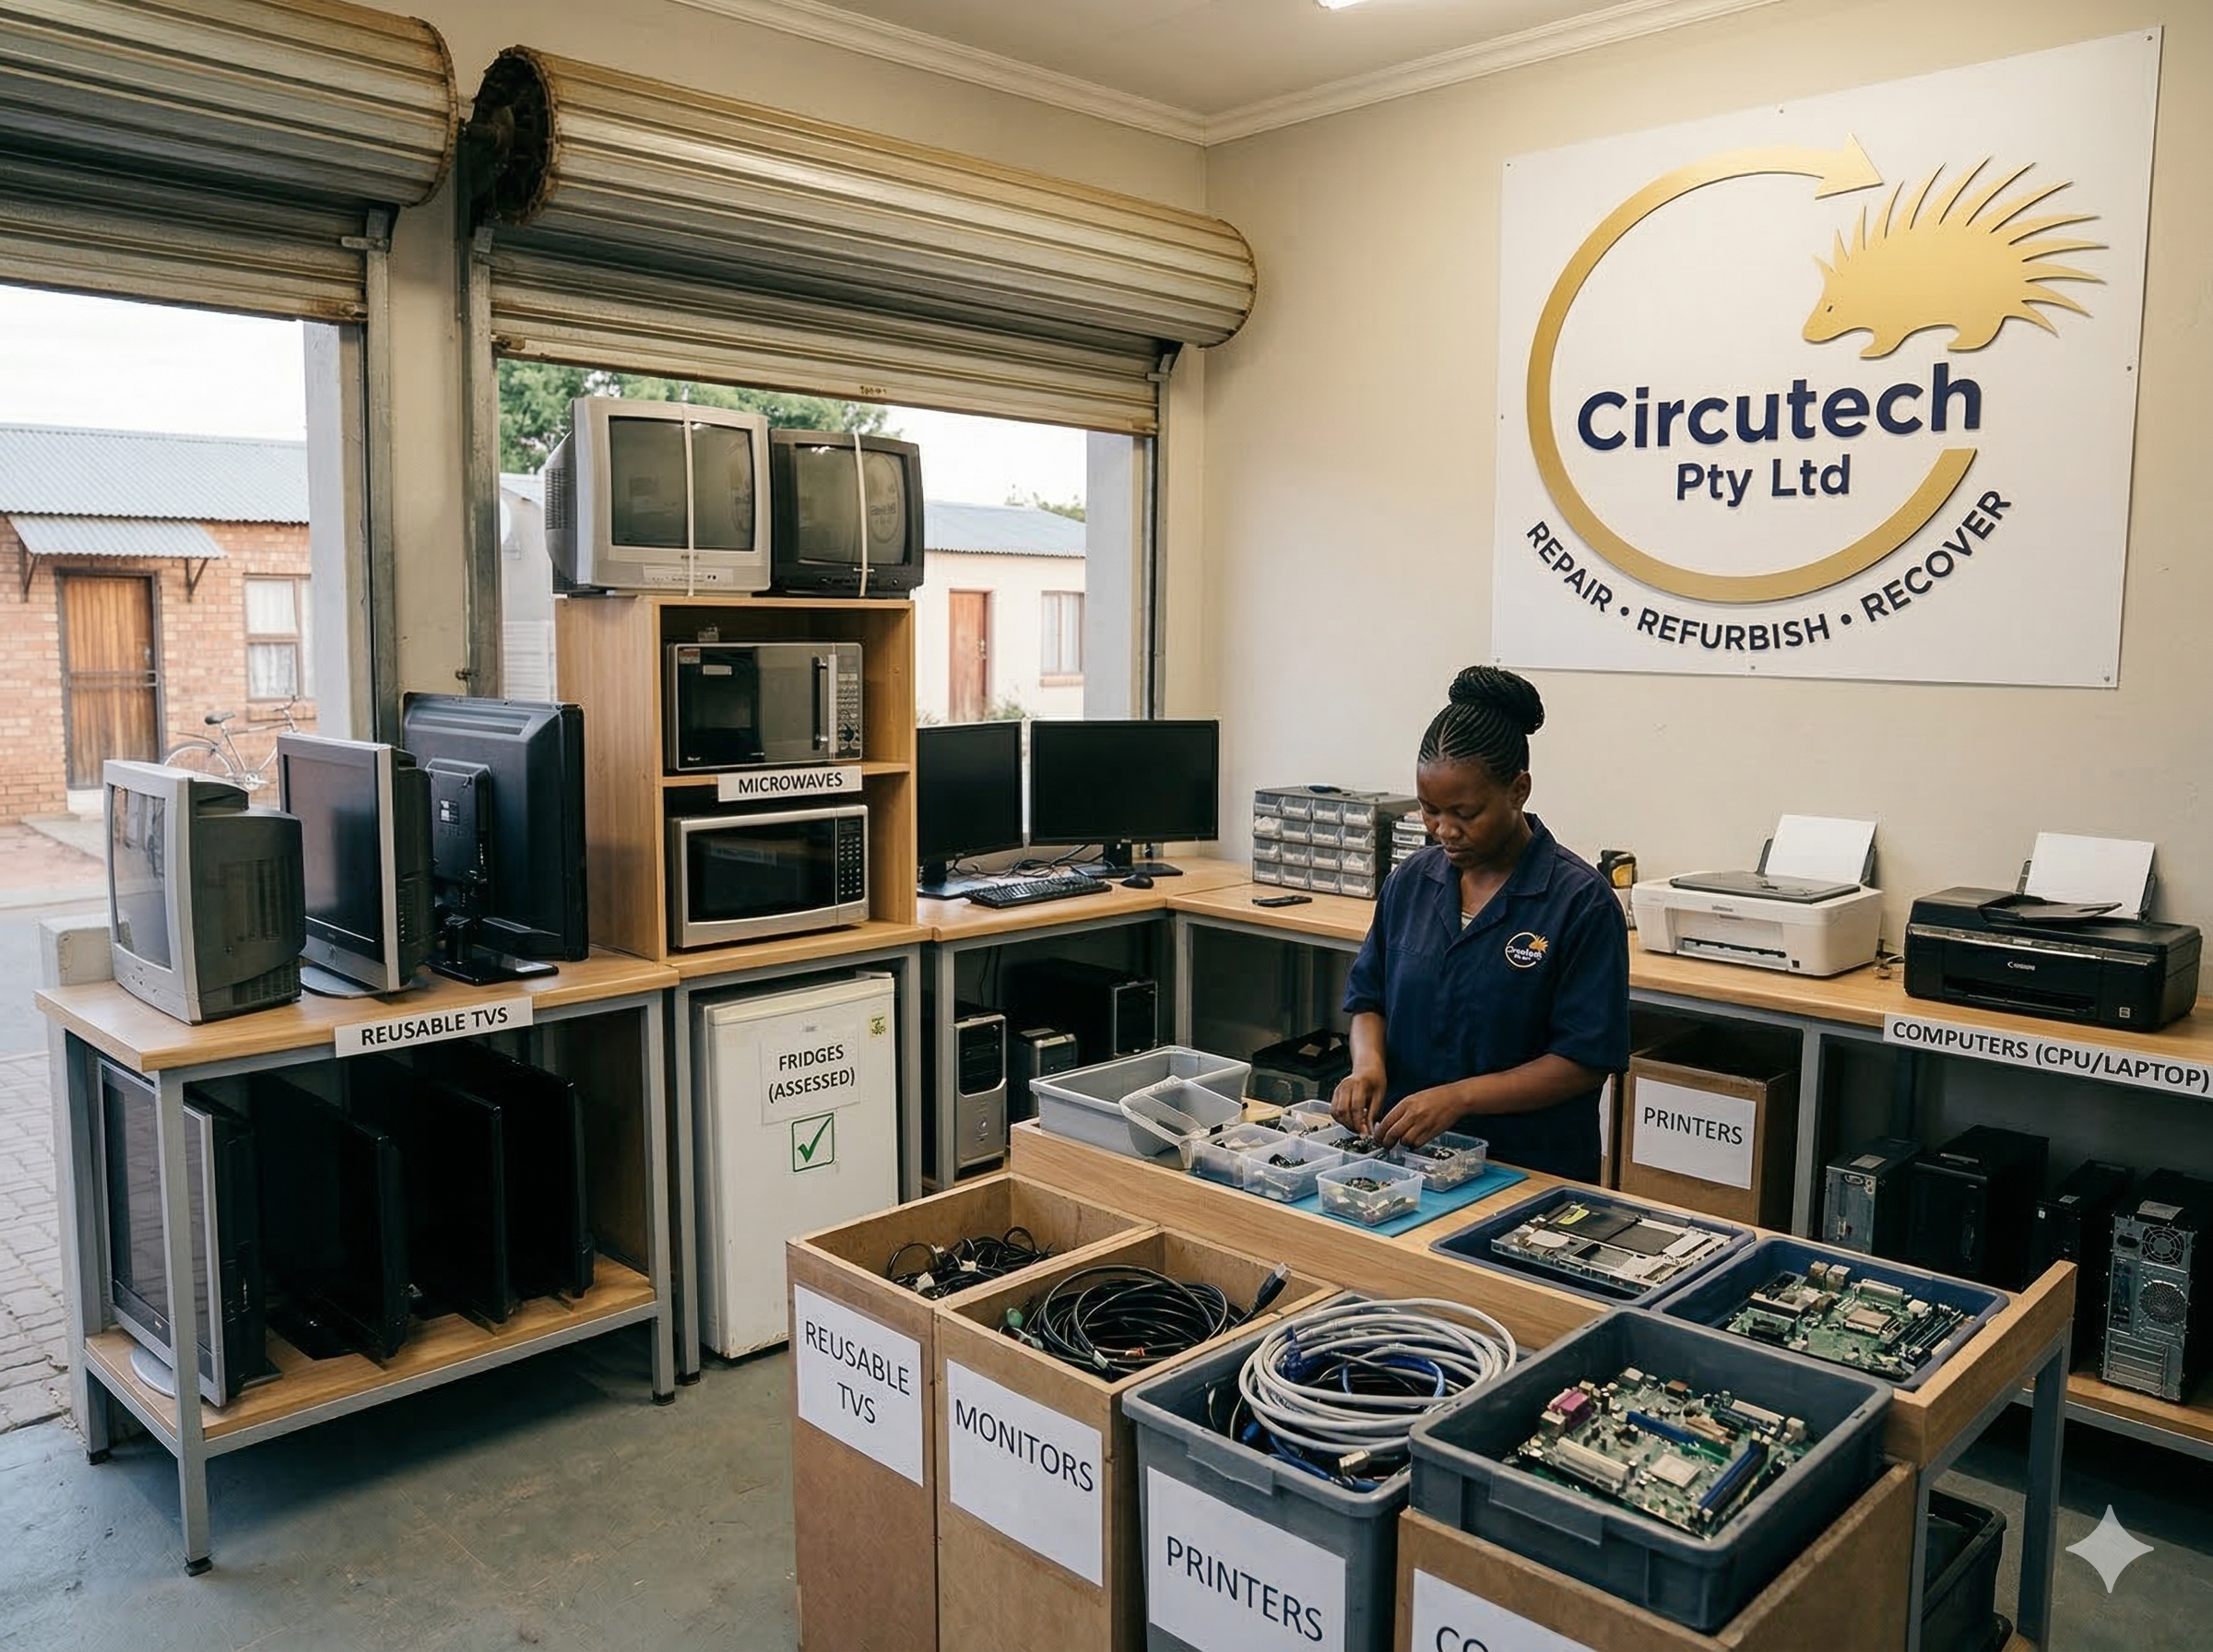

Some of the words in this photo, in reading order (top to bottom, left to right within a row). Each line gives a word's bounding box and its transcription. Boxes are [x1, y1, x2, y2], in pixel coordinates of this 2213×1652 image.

[1578, 362, 1982, 451] Circutech
[1676, 463, 1753, 508] Pty
[1771, 454, 1851, 498] Ltd
[1526, 521, 1613, 613] REPAIR
[1637, 608, 1830, 651] REFURBISH
[1860, 490, 2012, 622] RECOVER
[738, 772, 844, 794] MICROWAVES
[361, 1013, 466, 1046] REUSABLE
[470, 1007, 509, 1028] TVS
[778, 1044, 845, 1071] FRIDGES
[1892, 1021, 2029, 1059] COMPUTERS
[2035, 1043, 2210, 1094] (CPU/LAPTOP)
[768, 1067, 856, 1104] (ASSESSED)
[1643, 1106, 1743, 1145] PRINTERS
[805, 1320, 911, 1397] REUSABLE
[836, 1382, 877, 1425] TVS
[955, 1398, 1095, 1493] MONITORS
[1166, 1535, 1324, 1643] PRINTERS
